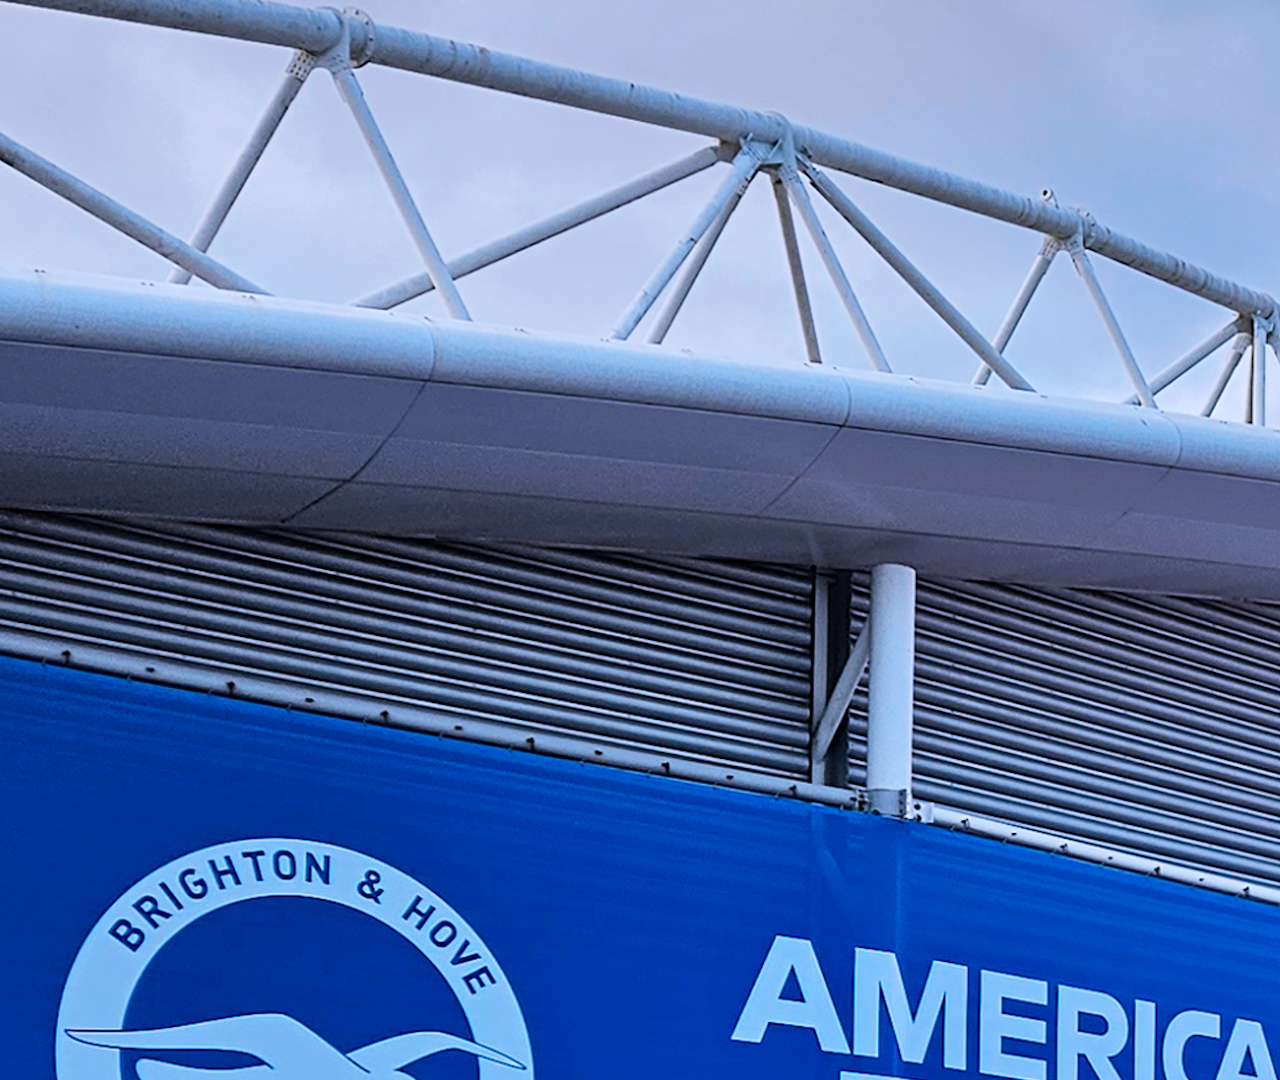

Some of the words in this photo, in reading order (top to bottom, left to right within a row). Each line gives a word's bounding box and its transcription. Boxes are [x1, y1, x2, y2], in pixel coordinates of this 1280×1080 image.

[108, 849, 332, 952] BRIGHTON
[356, 869, 384, 905] &
[402, 894, 496, 995] HOVE
